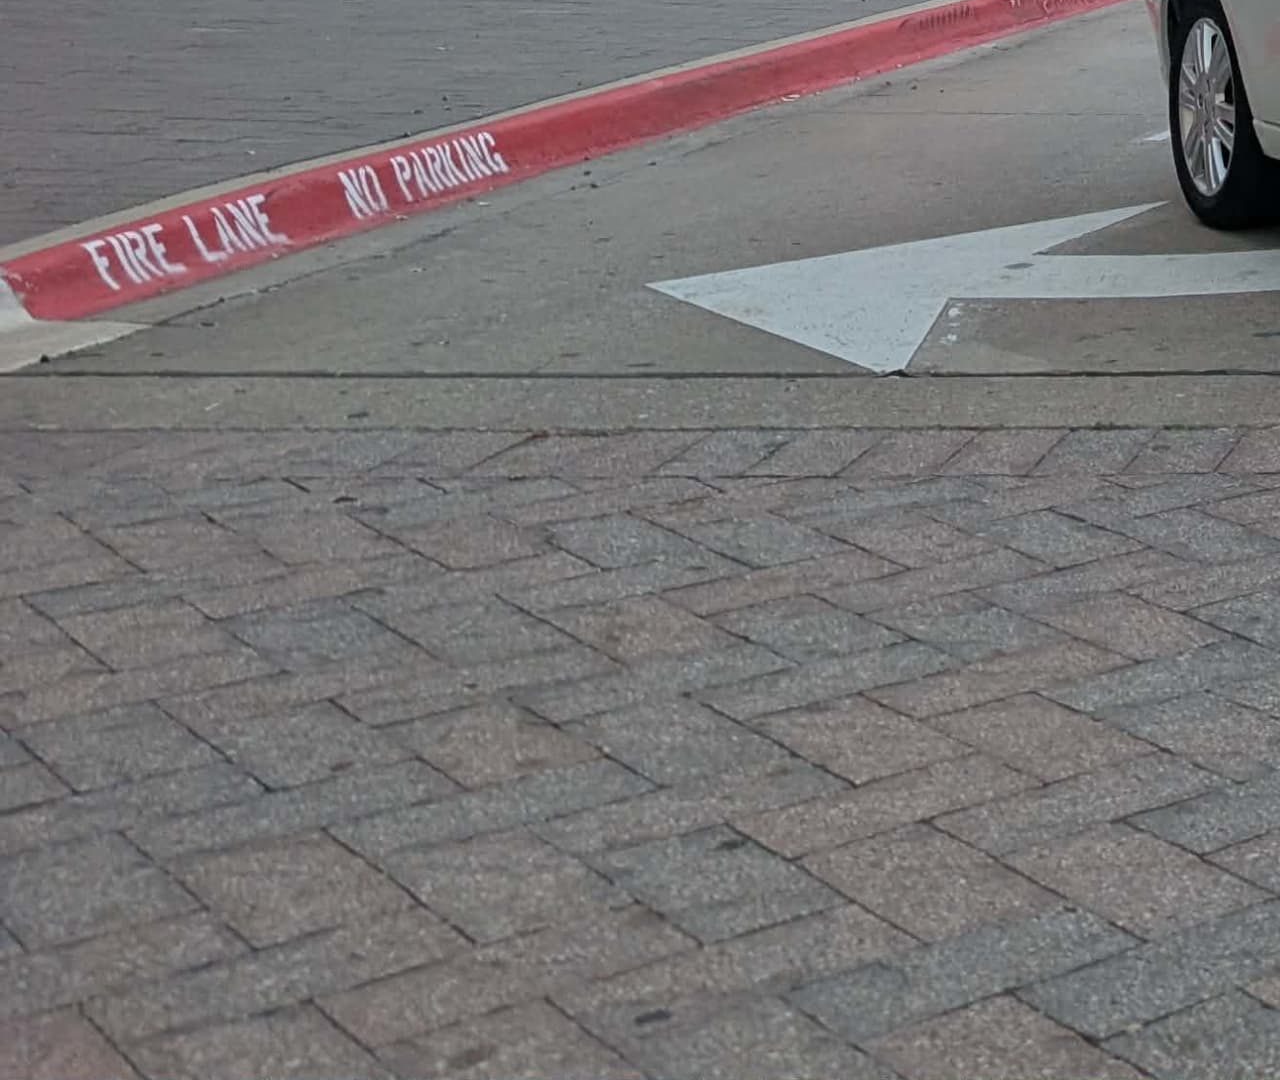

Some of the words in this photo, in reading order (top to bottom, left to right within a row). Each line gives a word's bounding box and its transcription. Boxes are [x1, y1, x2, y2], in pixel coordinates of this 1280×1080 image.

[337, 164, 389, 219] NO
[390, 131, 509, 202] PARKING
[80, 223, 188, 290] FIRE
[182, 193, 290, 262] LANE
